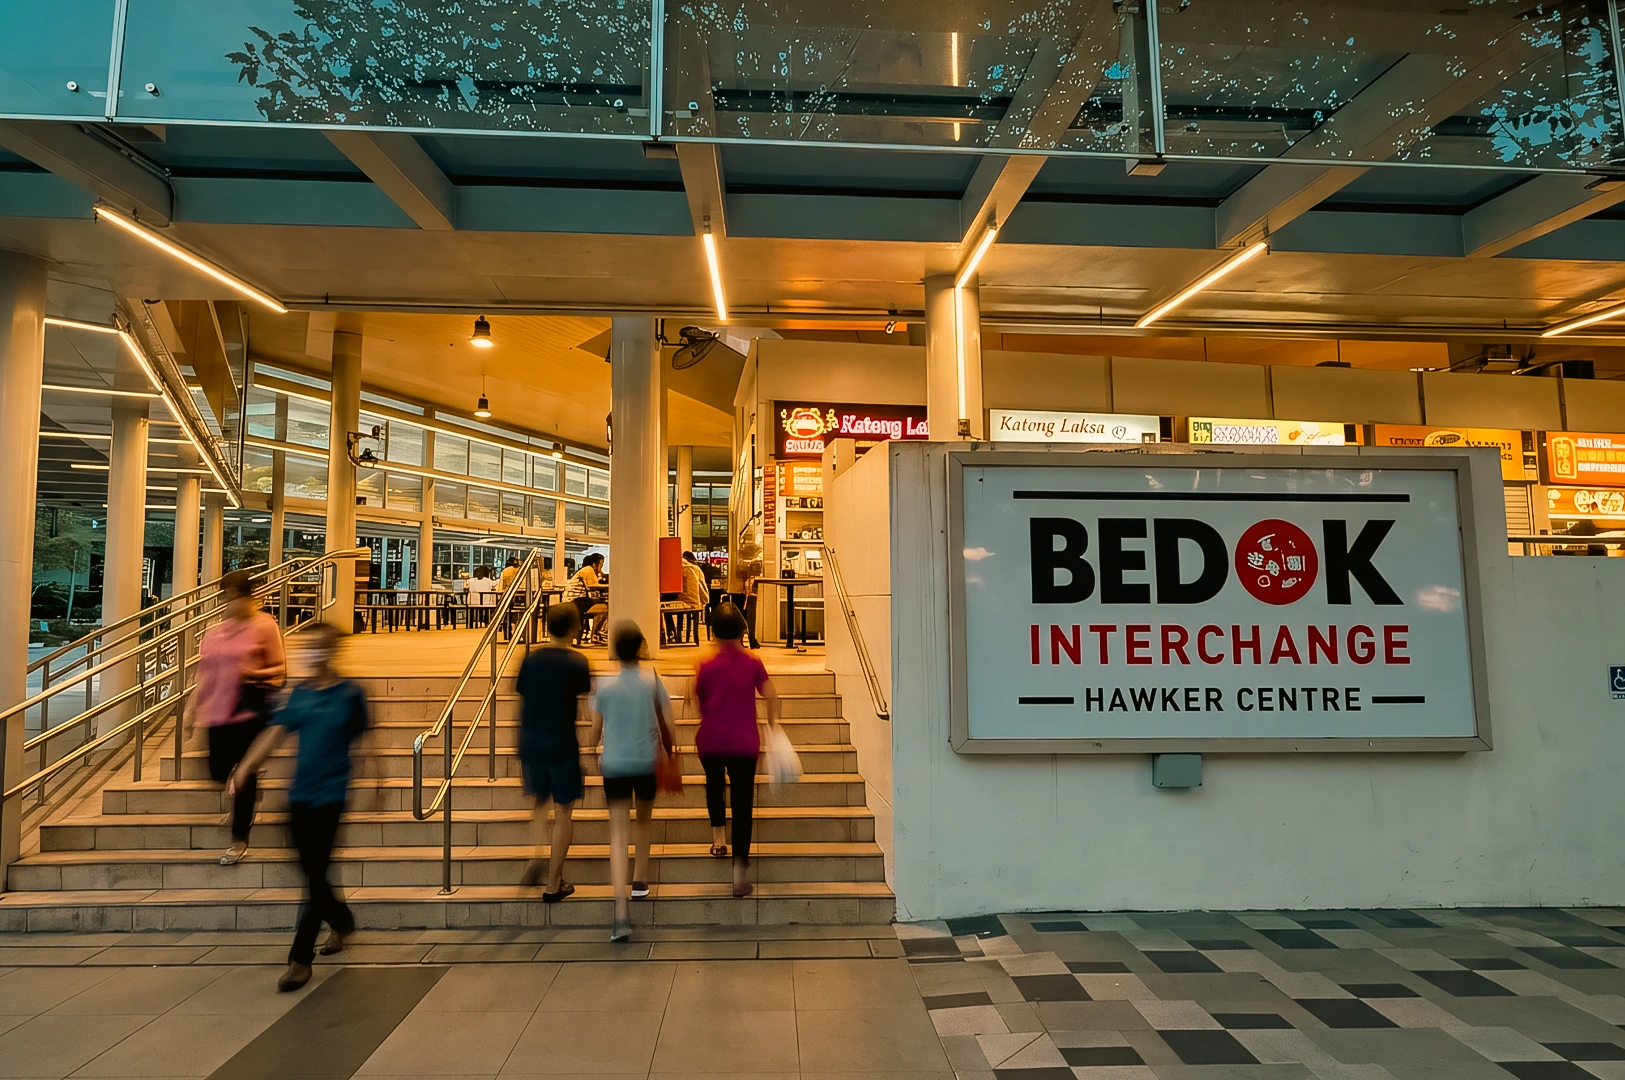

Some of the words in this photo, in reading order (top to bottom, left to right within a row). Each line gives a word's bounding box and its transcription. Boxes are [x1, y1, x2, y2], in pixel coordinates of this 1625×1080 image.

[906, 417, 929, 435] La
[1000, 415, 1055, 438] Katong
[1060, 418, 1105, 434] Laksa
[1029, 516, 1405, 606] BEDOK
[1030, 624, 1411, 665] INTERCHANGE
[1085, 687, 1225, 712] HAWKER
[1236, 687, 1362, 712] CENTRE
